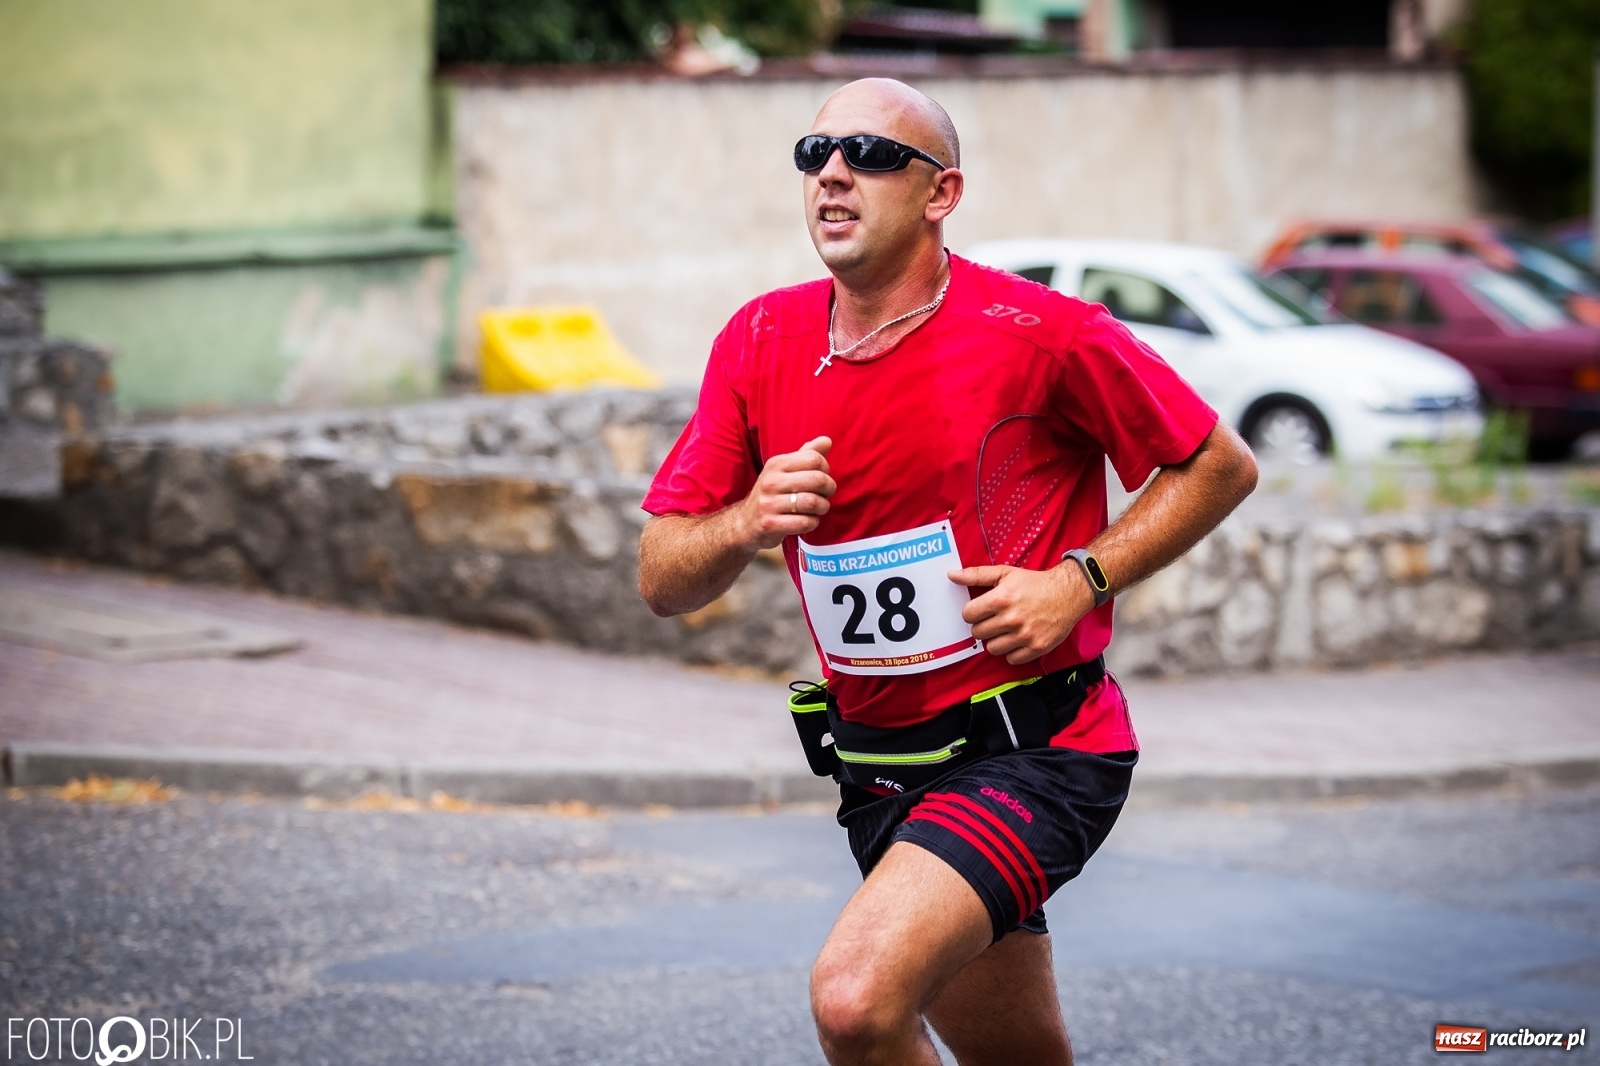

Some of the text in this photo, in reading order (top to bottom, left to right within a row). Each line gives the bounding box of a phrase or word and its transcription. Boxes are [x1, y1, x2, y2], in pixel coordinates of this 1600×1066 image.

[811, 558, 837, 573] BIEG
[839, 537, 943, 572] KRZANOWICKI
[831, 576, 921, 644] 28
[850, 658, 885, 667] Krzanowice,
[884, 658, 893, 666] 28
[893, 657, 909, 667] lipca
[910, 653, 929, 664] 2019
[979, 786, 1034, 824] adidas
